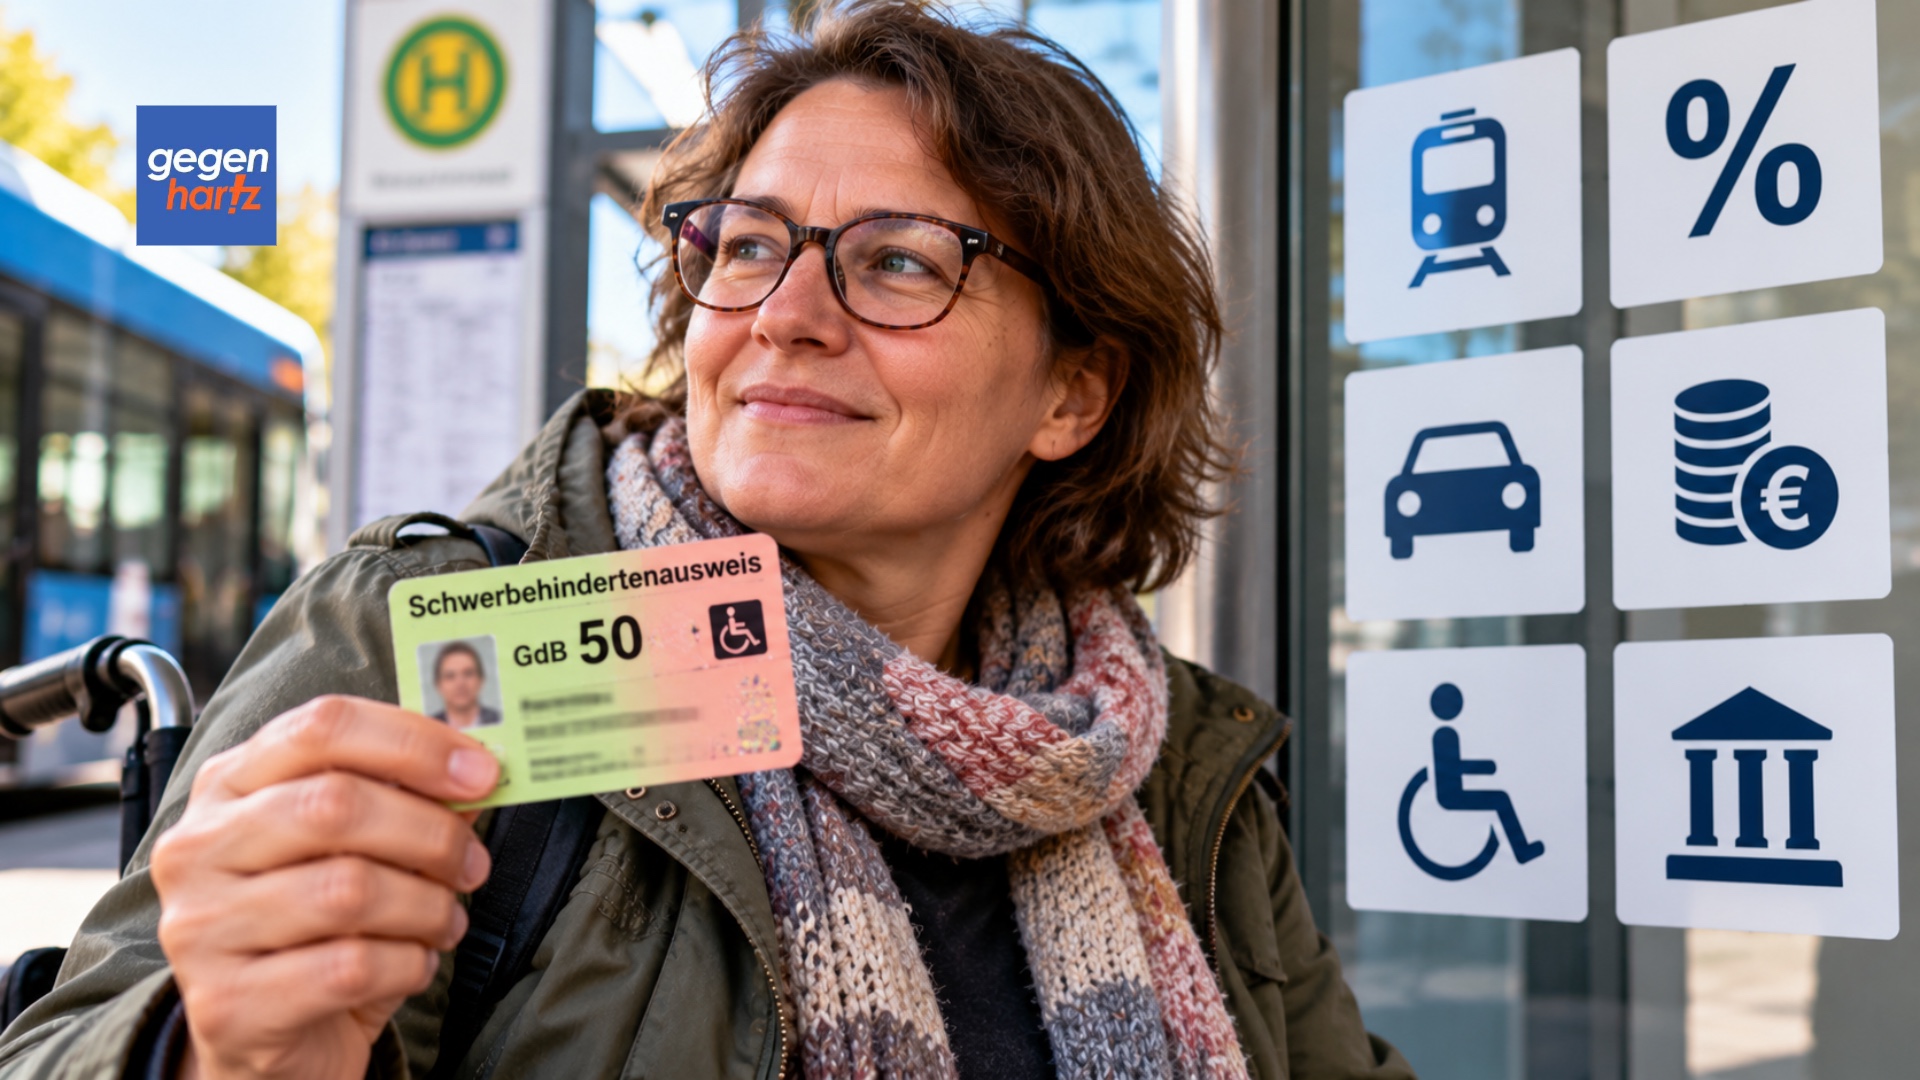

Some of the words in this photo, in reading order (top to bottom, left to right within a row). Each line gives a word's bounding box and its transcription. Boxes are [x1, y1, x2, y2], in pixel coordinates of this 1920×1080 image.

[1664, 63, 1824, 239] %
[408, 551, 763, 619] Schwerbehindertenausweis
[513, 640, 568, 668] GdB
[579, 614, 643, 665] 50
